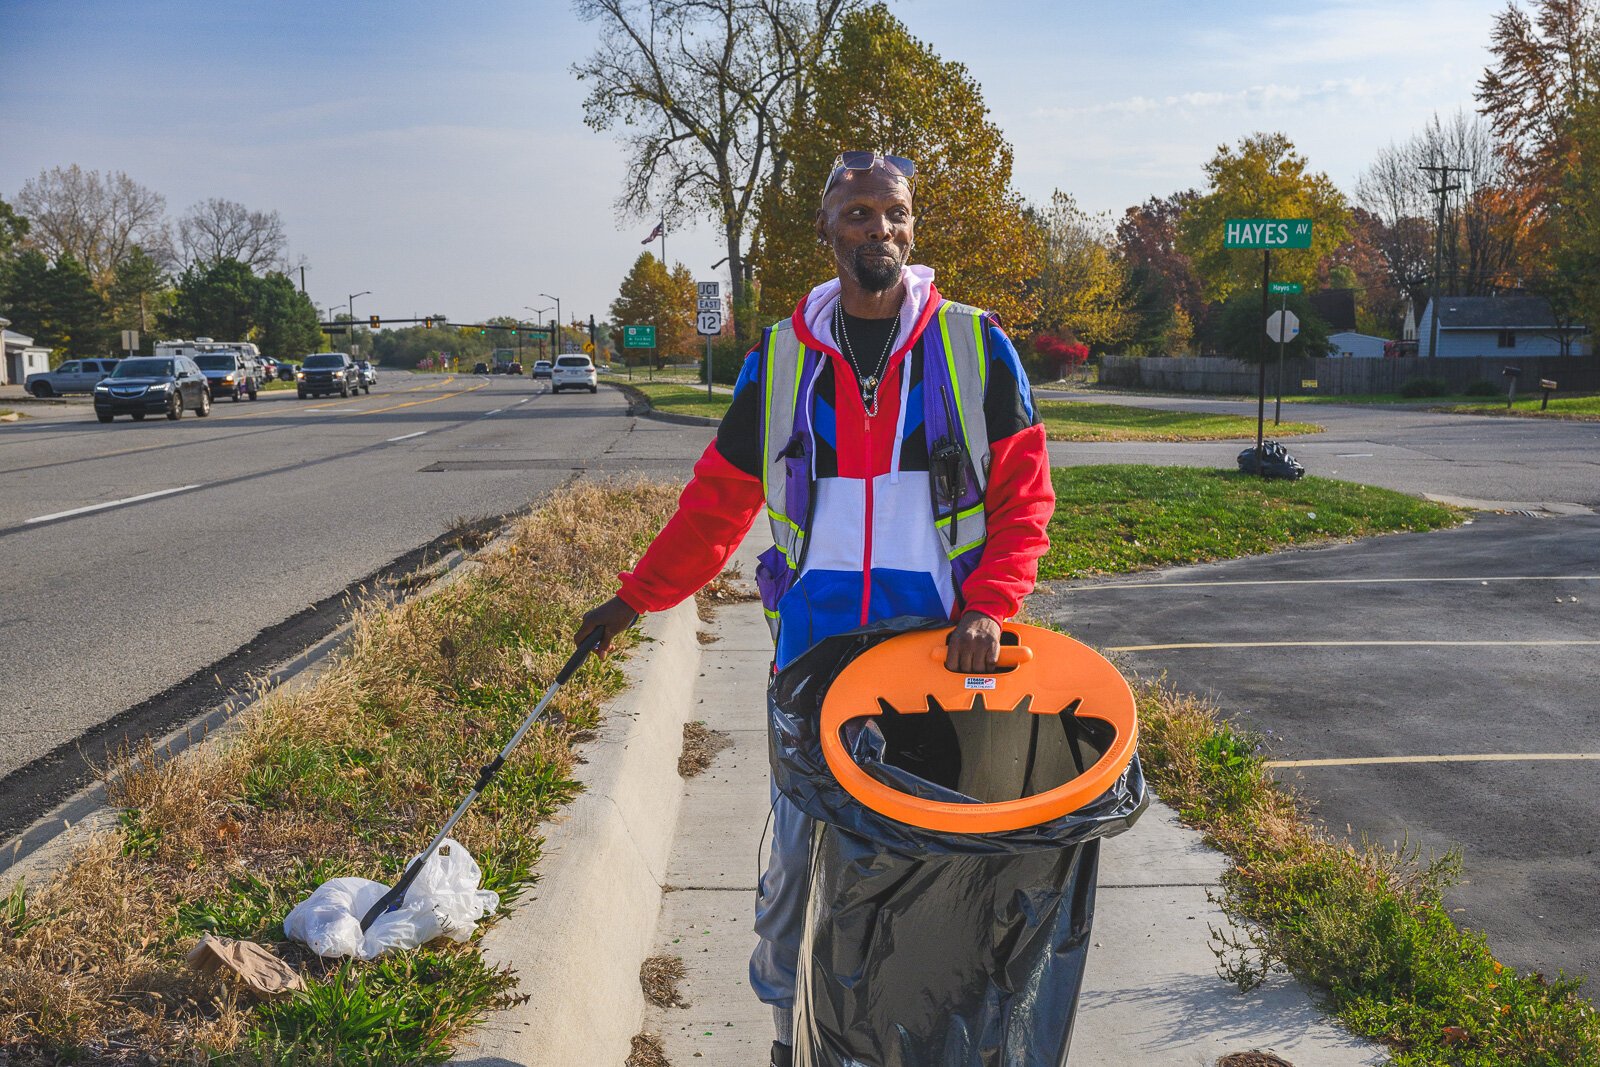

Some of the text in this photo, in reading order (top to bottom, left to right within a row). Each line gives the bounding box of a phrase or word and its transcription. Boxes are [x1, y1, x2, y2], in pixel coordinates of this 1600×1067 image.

[1227, 223, 1309, 245] HAYES AV
[700, 284, 717, 295] JCT
[1273, 284, 1290, 293] Hayes
[700, 301, 717, 309] EAST
[702, 316, 716, 330] 12
